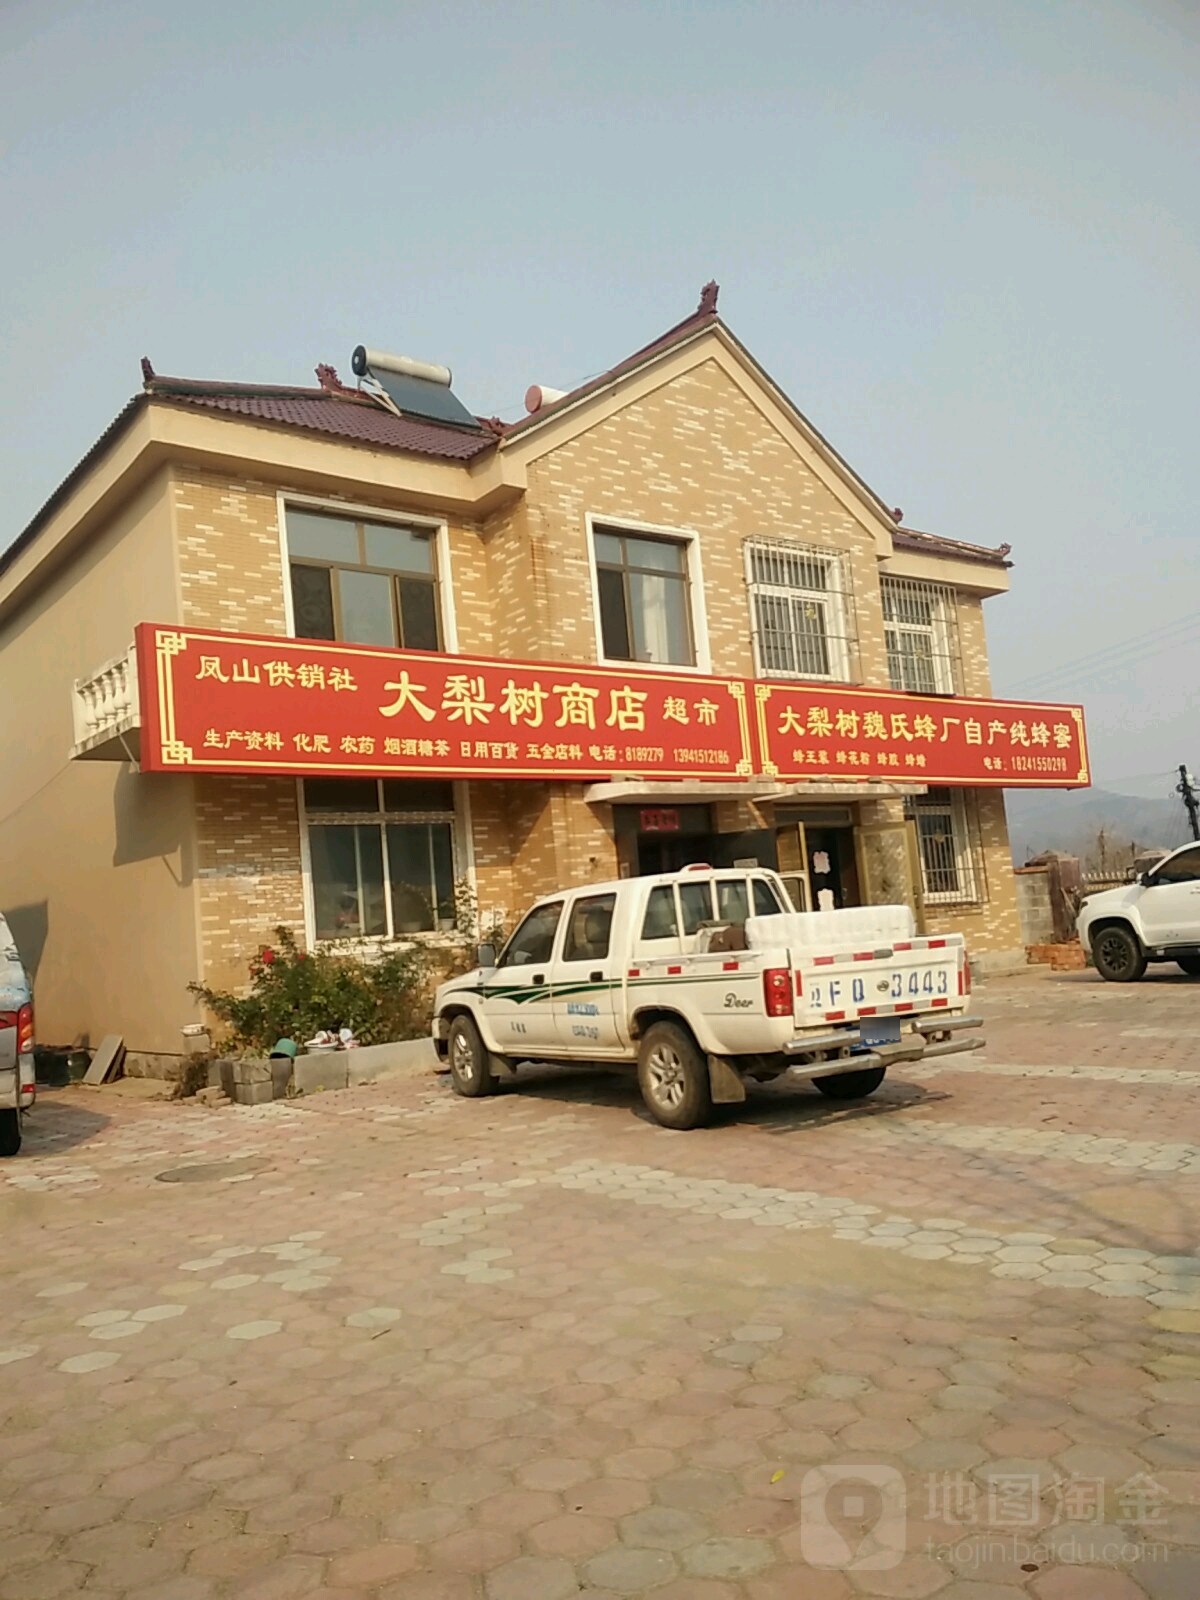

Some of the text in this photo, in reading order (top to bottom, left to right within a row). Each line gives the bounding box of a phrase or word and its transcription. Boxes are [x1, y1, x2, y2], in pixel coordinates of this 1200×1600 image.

[195, 656, 719, 731] 凤山供销社 大梨树商店 超市
[202, 728, 285, 751] 生产资料
[292, 733, 332, 753] 化肥
[339, 735, 376, 755] 农药
[383, 736, 451, 757] 烟酒糖茶
[460, 741, 519, 760] 日用百货
[777, 705, 1073, 749] 大梨树魏氏蜂厂自产纯蜂蜜
[723, 992, 753, 1008] Deer
